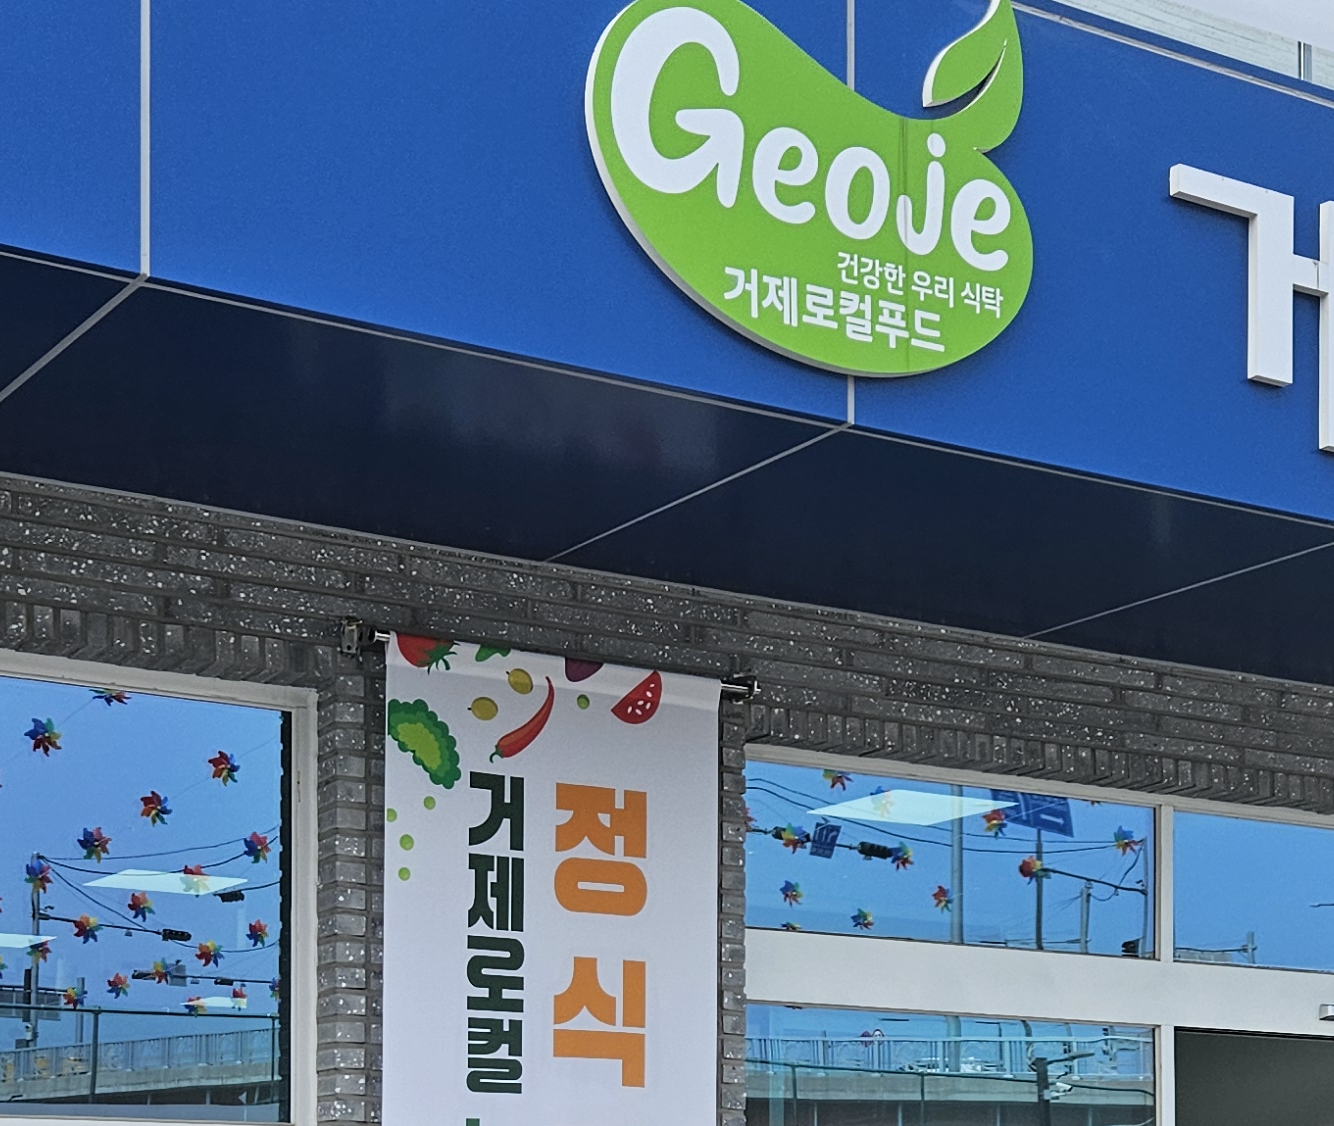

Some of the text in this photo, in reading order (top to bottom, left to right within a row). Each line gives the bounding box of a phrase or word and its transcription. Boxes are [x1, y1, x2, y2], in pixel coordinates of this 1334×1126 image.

[611, 6, 1010, 271] Geoje
[724, 266, 944, 353] 거제로컬푸드
[837, 251, 1003, 318] 건강한 우리 식탁
[466, 771, 525, 1094] 거제로컬
